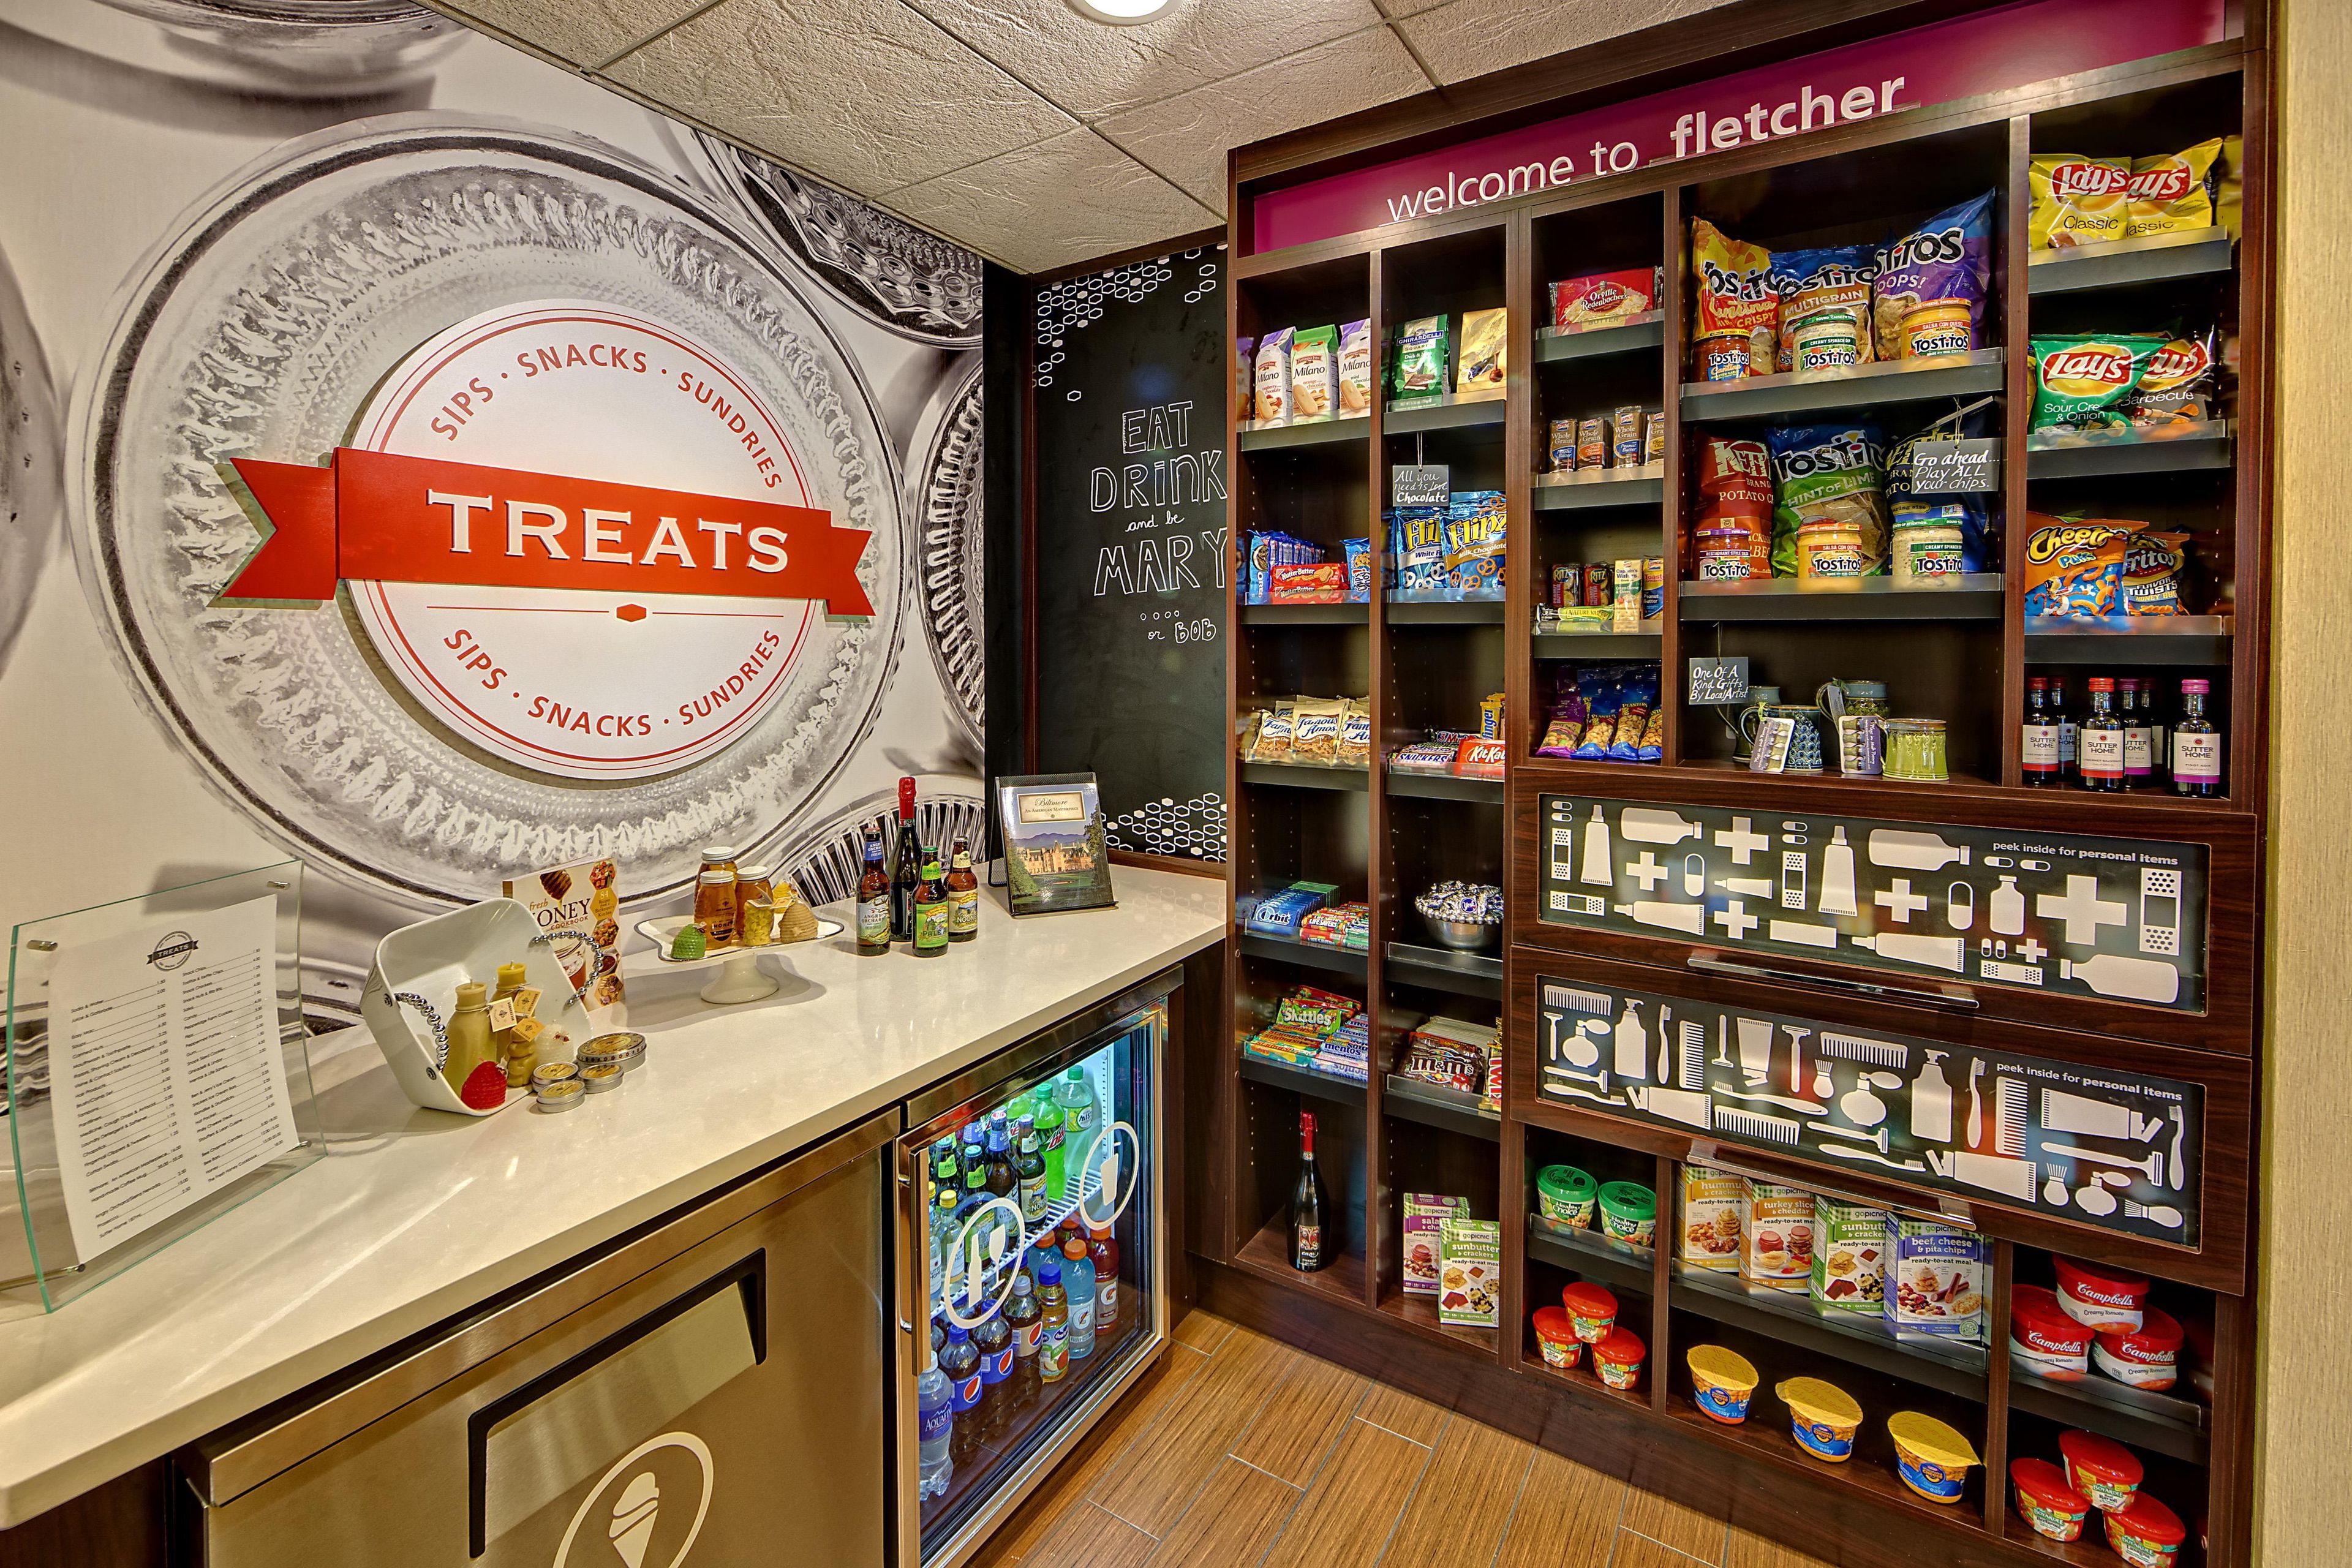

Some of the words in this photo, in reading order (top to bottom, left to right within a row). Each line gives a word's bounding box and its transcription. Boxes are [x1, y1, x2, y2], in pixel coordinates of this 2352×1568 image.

[1385, 155, 1574, 222] welcome
[1589, 141, 1638, 176] to
[1670, 75, 1905, 158] fletcher
[2060, 165, 2127, 195] Lay's
[2064, 216, 2118, 230] Classic
[1581, 293, 1628, 311] Redenbacher's
[1590, 288, 1617, 303] Orville
[1785, 290, 1863, 316] MULTIGRAIN
[1588, 317, 1619, 325] BUTTER
[1737, 312, 1774, 327] CRISPY
[1398, 331, 1442, 344] GHIRARDELLI
[1293, 365, 1325, 379] Milano
[2047, 355, 2128, 380] Lay's
[1256, 372, 1279, 385] Milano
[2120, 391, 2195, 407] Barbecue
[2045, 402, 2073, 413] Sour
[431, 377, 494, 441] SIPS
[517, 344, 647, 377] SNACKS
[677, 372, 782, 489] SUNDRIES
[2056, 413, 2064, 422] &
[2067, 410, 2105, 421] Onion
[1123, 401, 1193, 454] EAT
[1913, 453, 1937, 467] Go
[1395, 470, 1412, 482] All
[1417, 473, 1440, 486] you
[1915, 466, 1950, 482] Play
[1951, 465, 1986, 477] ALL
[1394, 483, 1417, 492] need
[1746, 478, 1771, 488] BRAND
[1789, 486, 1824, 507] HINT
[1826, 483, 1842, 492] OF
[1842, 472, 1875, 489] LIME
[1915, 480, 1947, 493] your
[1949, 477, 1989, 491] chips.
[1396, 492, 1449, 503] Chocolate
[1719, 491, 1765, 501] POTATO
[1125, 514, 1159, 532] and
[1165, 510, 1185, 526] be
[426, 488, 789, 573] TREATS
[1094, 527, 1227, 596] MARY
[2123, 548, 2176, 575] Fritos
[1553, 568, 1569, 581] RITZ
[1590, 568, 1607, 582] RITZ
[2136, 576, 2171, 590] FLAVOR
[2136, 592, 2160, 601] HONEY
[2162, 590, 2177, 599] BBQ
[1148, 630, 1165, 641] or
[1174, 618, 1216, 644] BOB
[1693, 666, 1713, 680] One
[1714, 666, 1728, 678] Of
[1730, 665, 1738, 677] A
[443, 628, 508, 690] SIPS
[527, 695, 652, 737] SNACKS
[678, 630, 780, 726] SUNDRIES
[1692, 679, 1715, 690] Kind
[1717, 679, 1743, 690] Gifts
[1690, 690, 1703, 701] By
[1295, 716, 1338, 731] Famous
[1302, 725, 1336, 737] Amos
[1993, 842, 2020, 853] peek
[2023, 843, 2056, 854] inside
[2059, 845, 2076, 856] for
[2079, 848, 2136, 862] personal
[2140, 854, 2178, 865] items
[529, 898, 548, 911] fresh
[533, 898, 590, 927] ONEY
[551, 916, 589, 930] COOKBOOK
[157, 944, 188, 957] TREATS
[1284, 1008, 1332, 1026] Skittles
[1324, 1042, 1362, 1056] mentos
[1997, 1062, 2024, 1074] peek
[2027, 1066, 2060, 1080] inside
[2063, 1072, 2080, 1083] for
[2082, 1076, 2140, 1094] personal
[2144, 1087, 2183, 1101] items
[1553, 1205, 1579, 1216] Choice
[1764, 1201, 1792, 1212] turkey
[1452, 1243, 1499, 1253] sunbutter
[1938, 1238, 1972, 1248] cheese
[1943, 1246, 1966, 1254] chips
[2077, 1282, 2135, 1306] Campbell's
[2029, 1330, 2082, 1352] Campbell's
